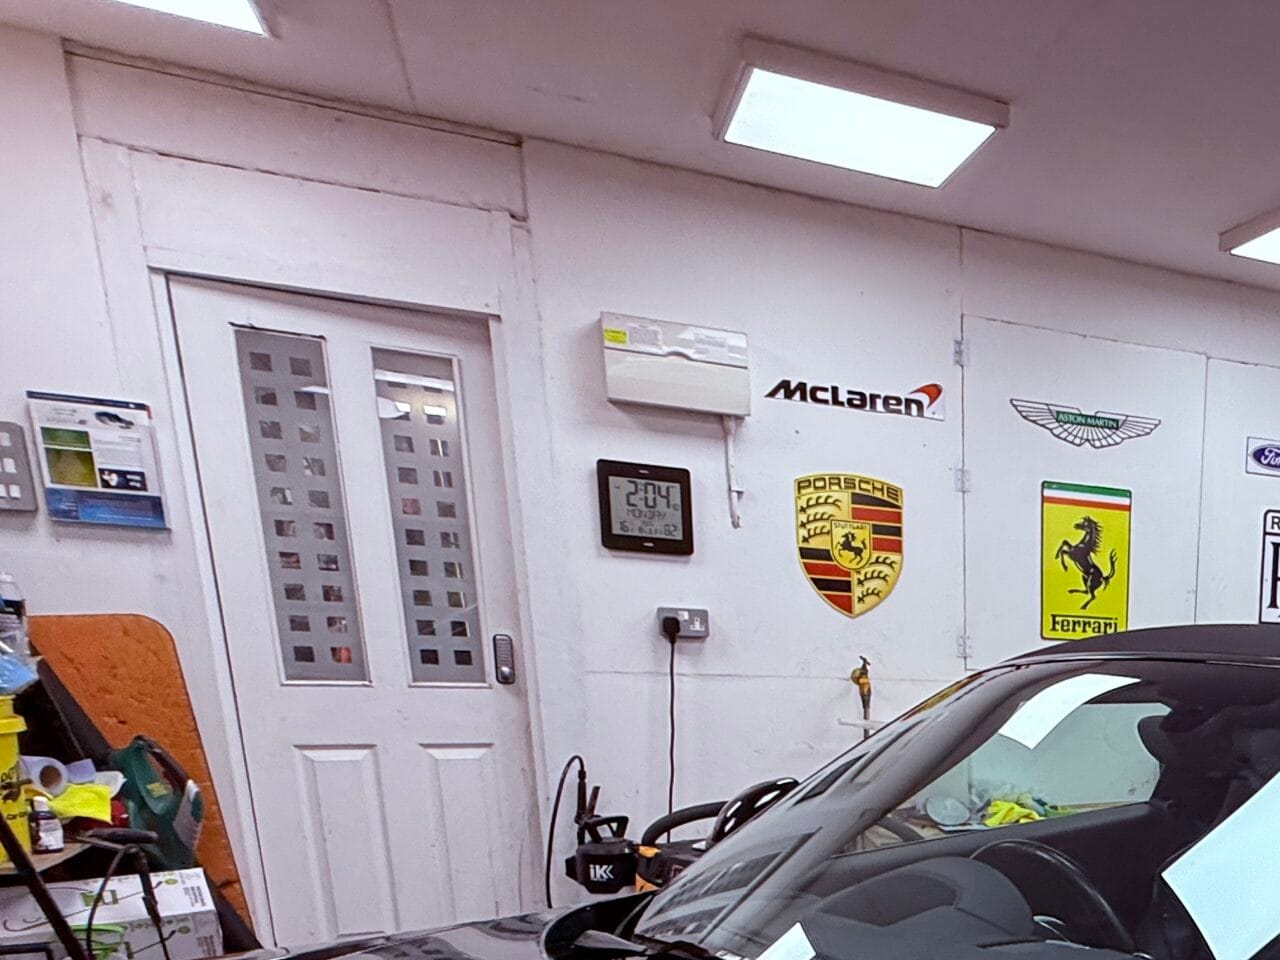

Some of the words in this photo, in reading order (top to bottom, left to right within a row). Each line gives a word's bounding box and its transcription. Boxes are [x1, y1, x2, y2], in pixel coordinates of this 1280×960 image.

[765, 380, 924, 417] McLaren
[1058, 413, 1085, 425] ASTON
[1087, 417, 1118, 428] MARTIN
[626, 480, 671, 509] 2:04
[797, 477, 900, 503] PORSCHE
[1050, 613, 1118, 634] Ferrari
